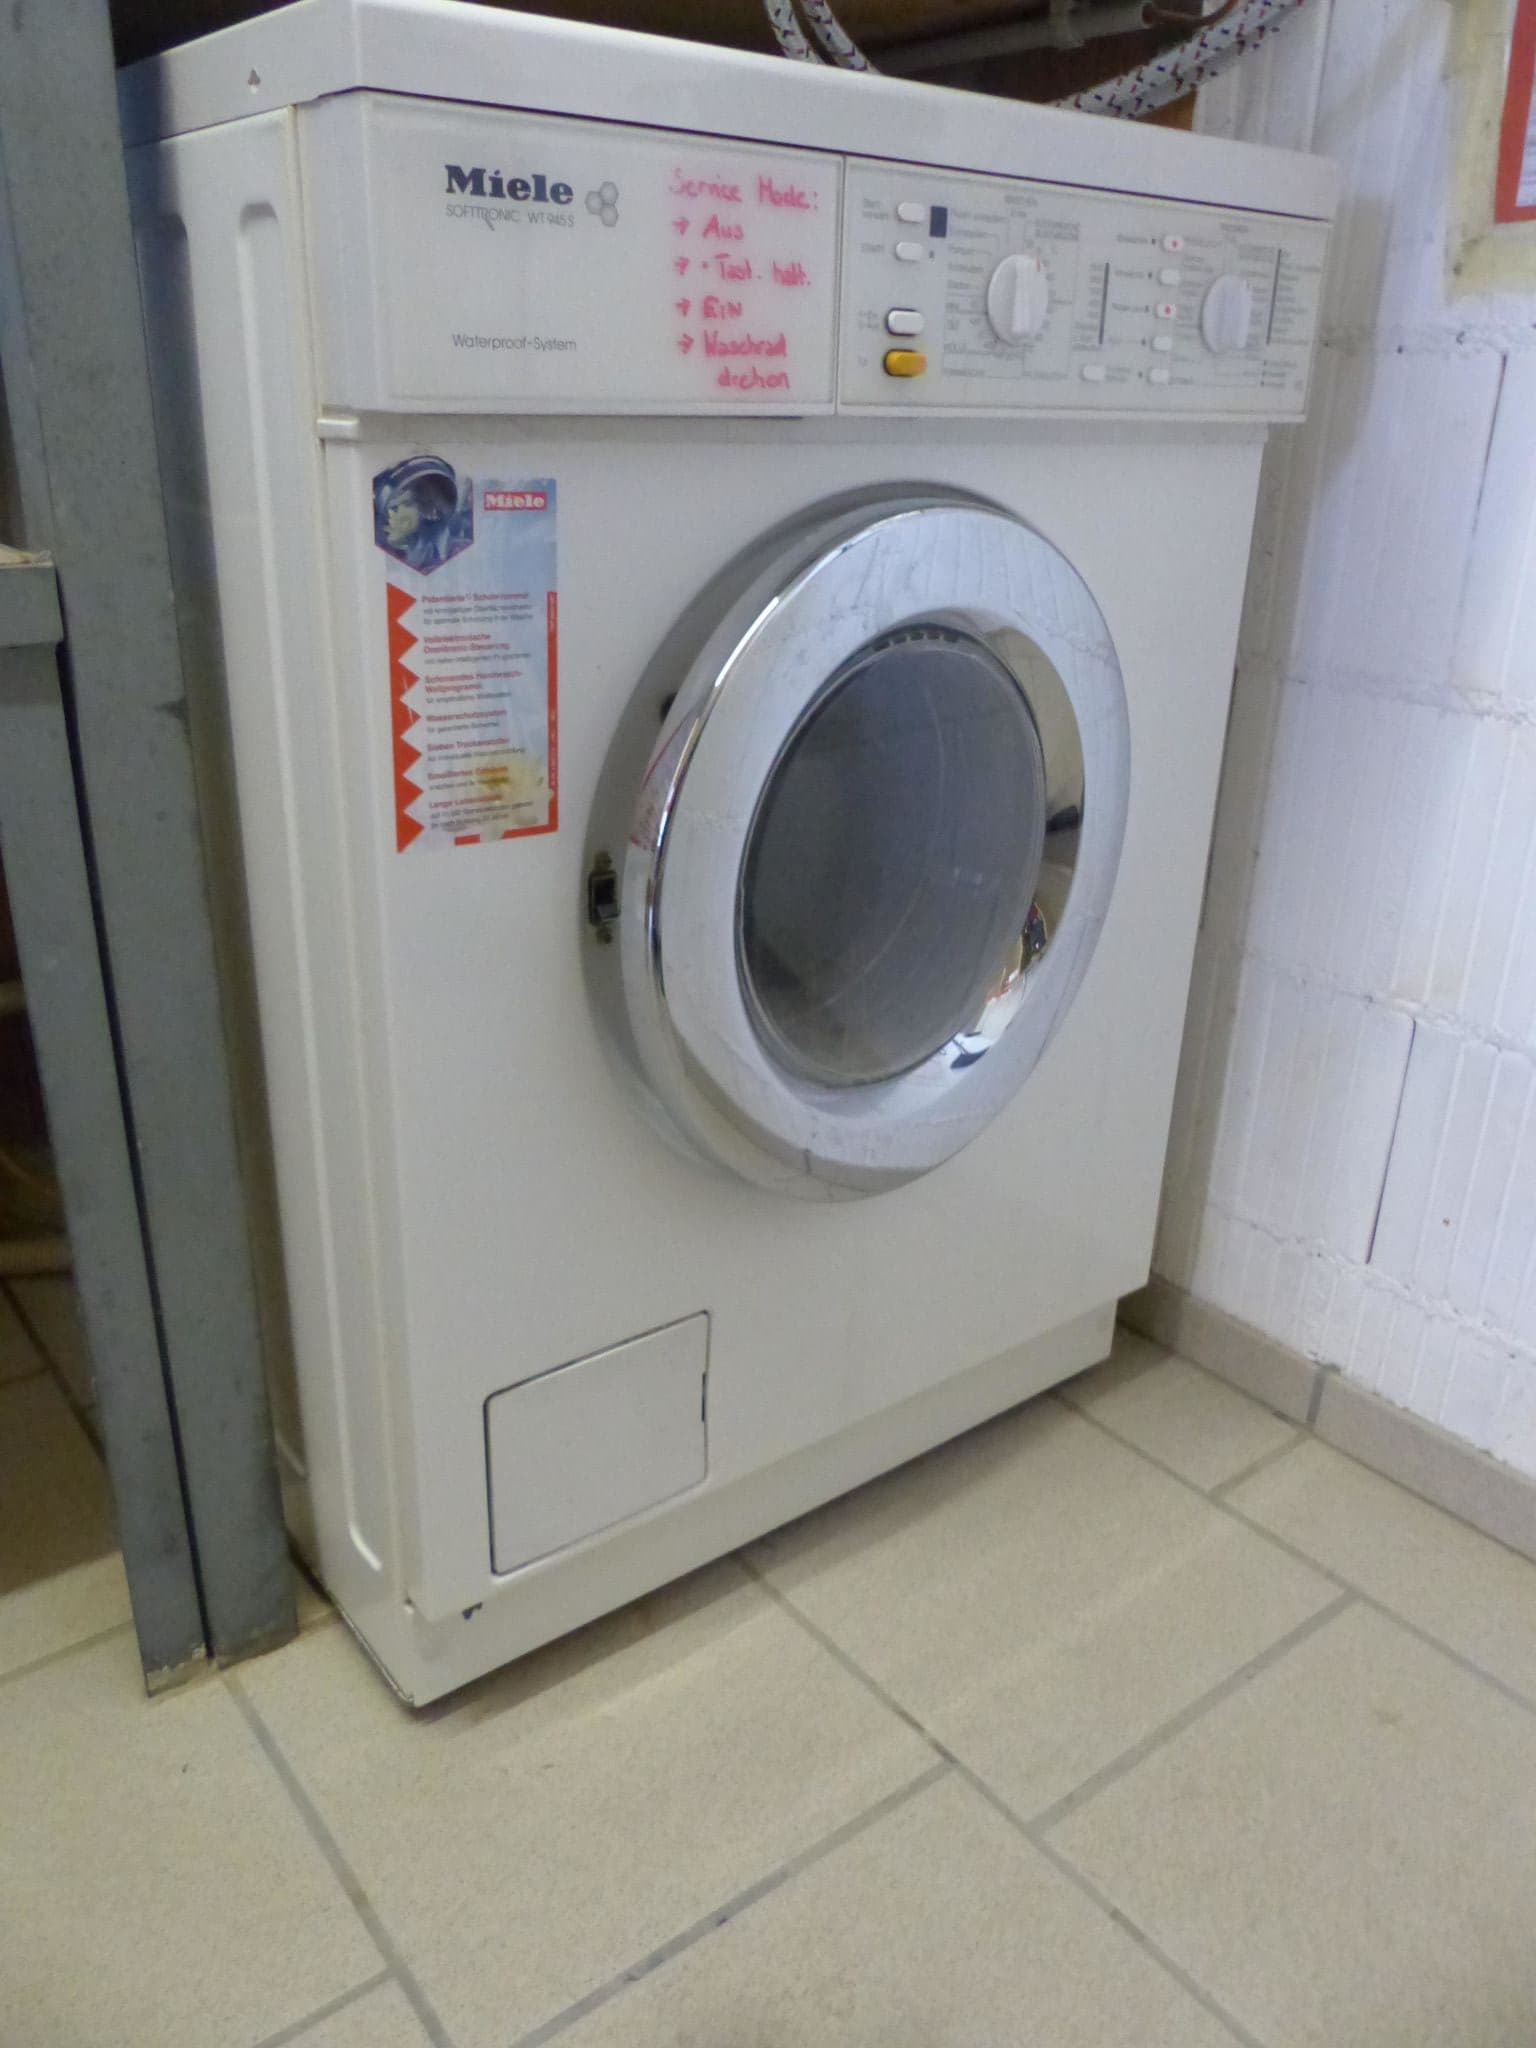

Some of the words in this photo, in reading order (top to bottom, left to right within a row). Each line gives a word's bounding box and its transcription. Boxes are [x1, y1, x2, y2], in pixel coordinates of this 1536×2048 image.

[444, 164, 574, 205] Miele
[701, 213, 745, 240] Aus
[453, 333, 577, 351] Waterproof-System
[485, 493, 546, 510] Miele
